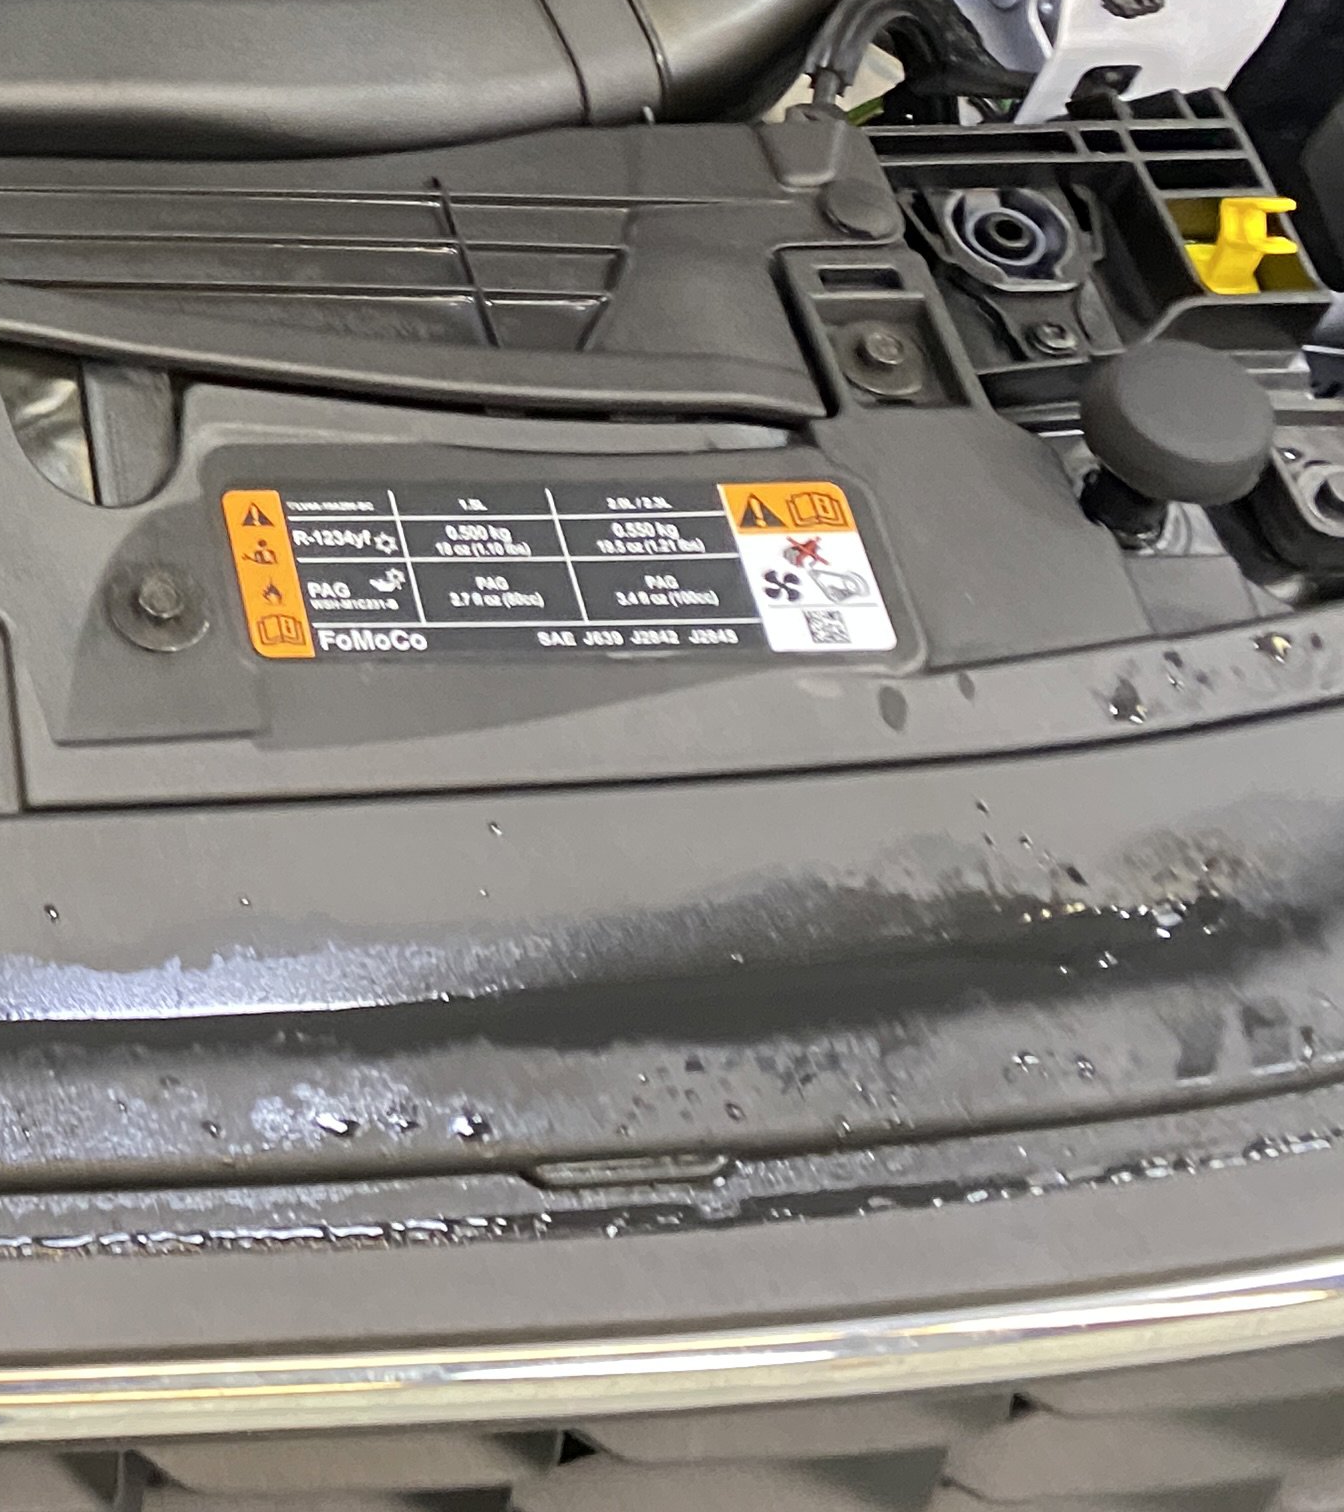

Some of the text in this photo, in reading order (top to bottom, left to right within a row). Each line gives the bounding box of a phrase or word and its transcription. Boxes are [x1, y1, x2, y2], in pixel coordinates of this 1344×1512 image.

[291, 529, 373, 549] R-1234yf
[444, 524, 512, 543] 0.500 kg
[611, 521, 680, 541] 0.550 kg
[307, 581, 352, 599] PAG
[474, 576, 510, 591] PAG
[643, 574, 680, 589] PAG
[316, 629, 429, 652] FoMoCo
[536, 630, 577, 647] SAE
